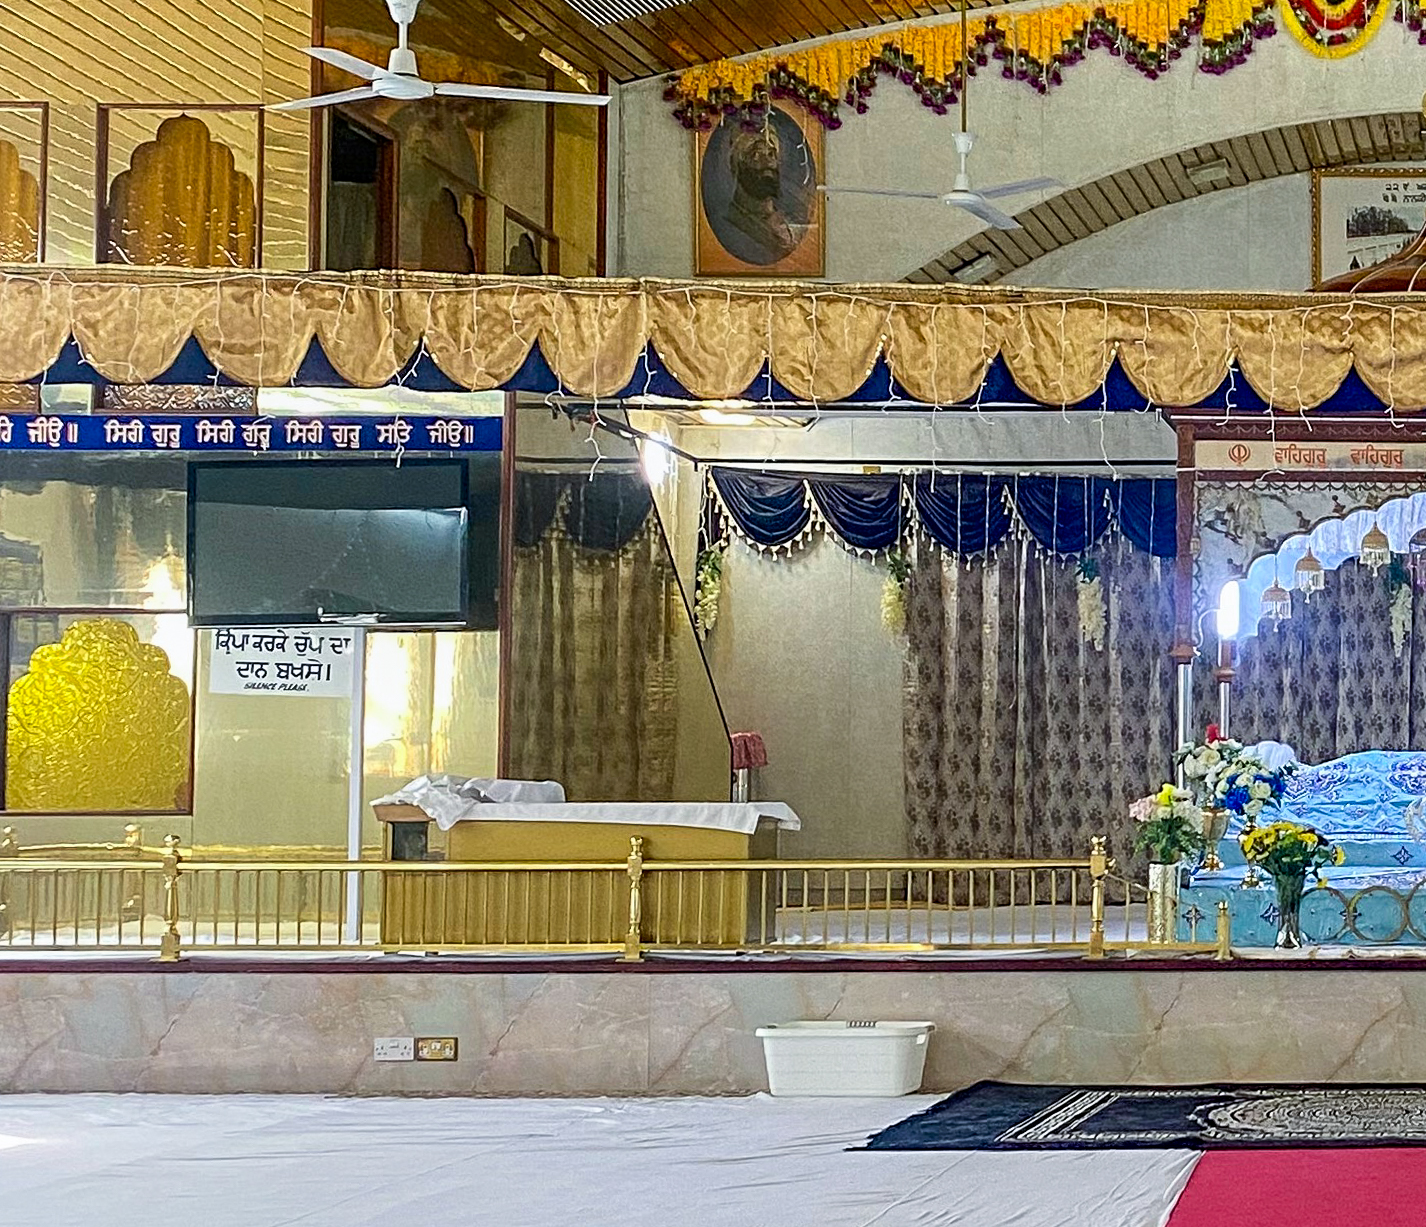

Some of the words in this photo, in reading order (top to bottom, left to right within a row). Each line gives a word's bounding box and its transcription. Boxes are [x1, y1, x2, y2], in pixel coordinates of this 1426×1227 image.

[104, 419, 145, 443] ਸਿਰੀ
[195, 419, 236, 443] ਸਿਰੀ
[285, 420, 324, 443] ਸਿਰੀ
[252, 629, 289, 652] ਕਰਕੇ
[329, 637, 351, 654] ਦਾ
[235, 661, 269, 679] ਦਾਨ
